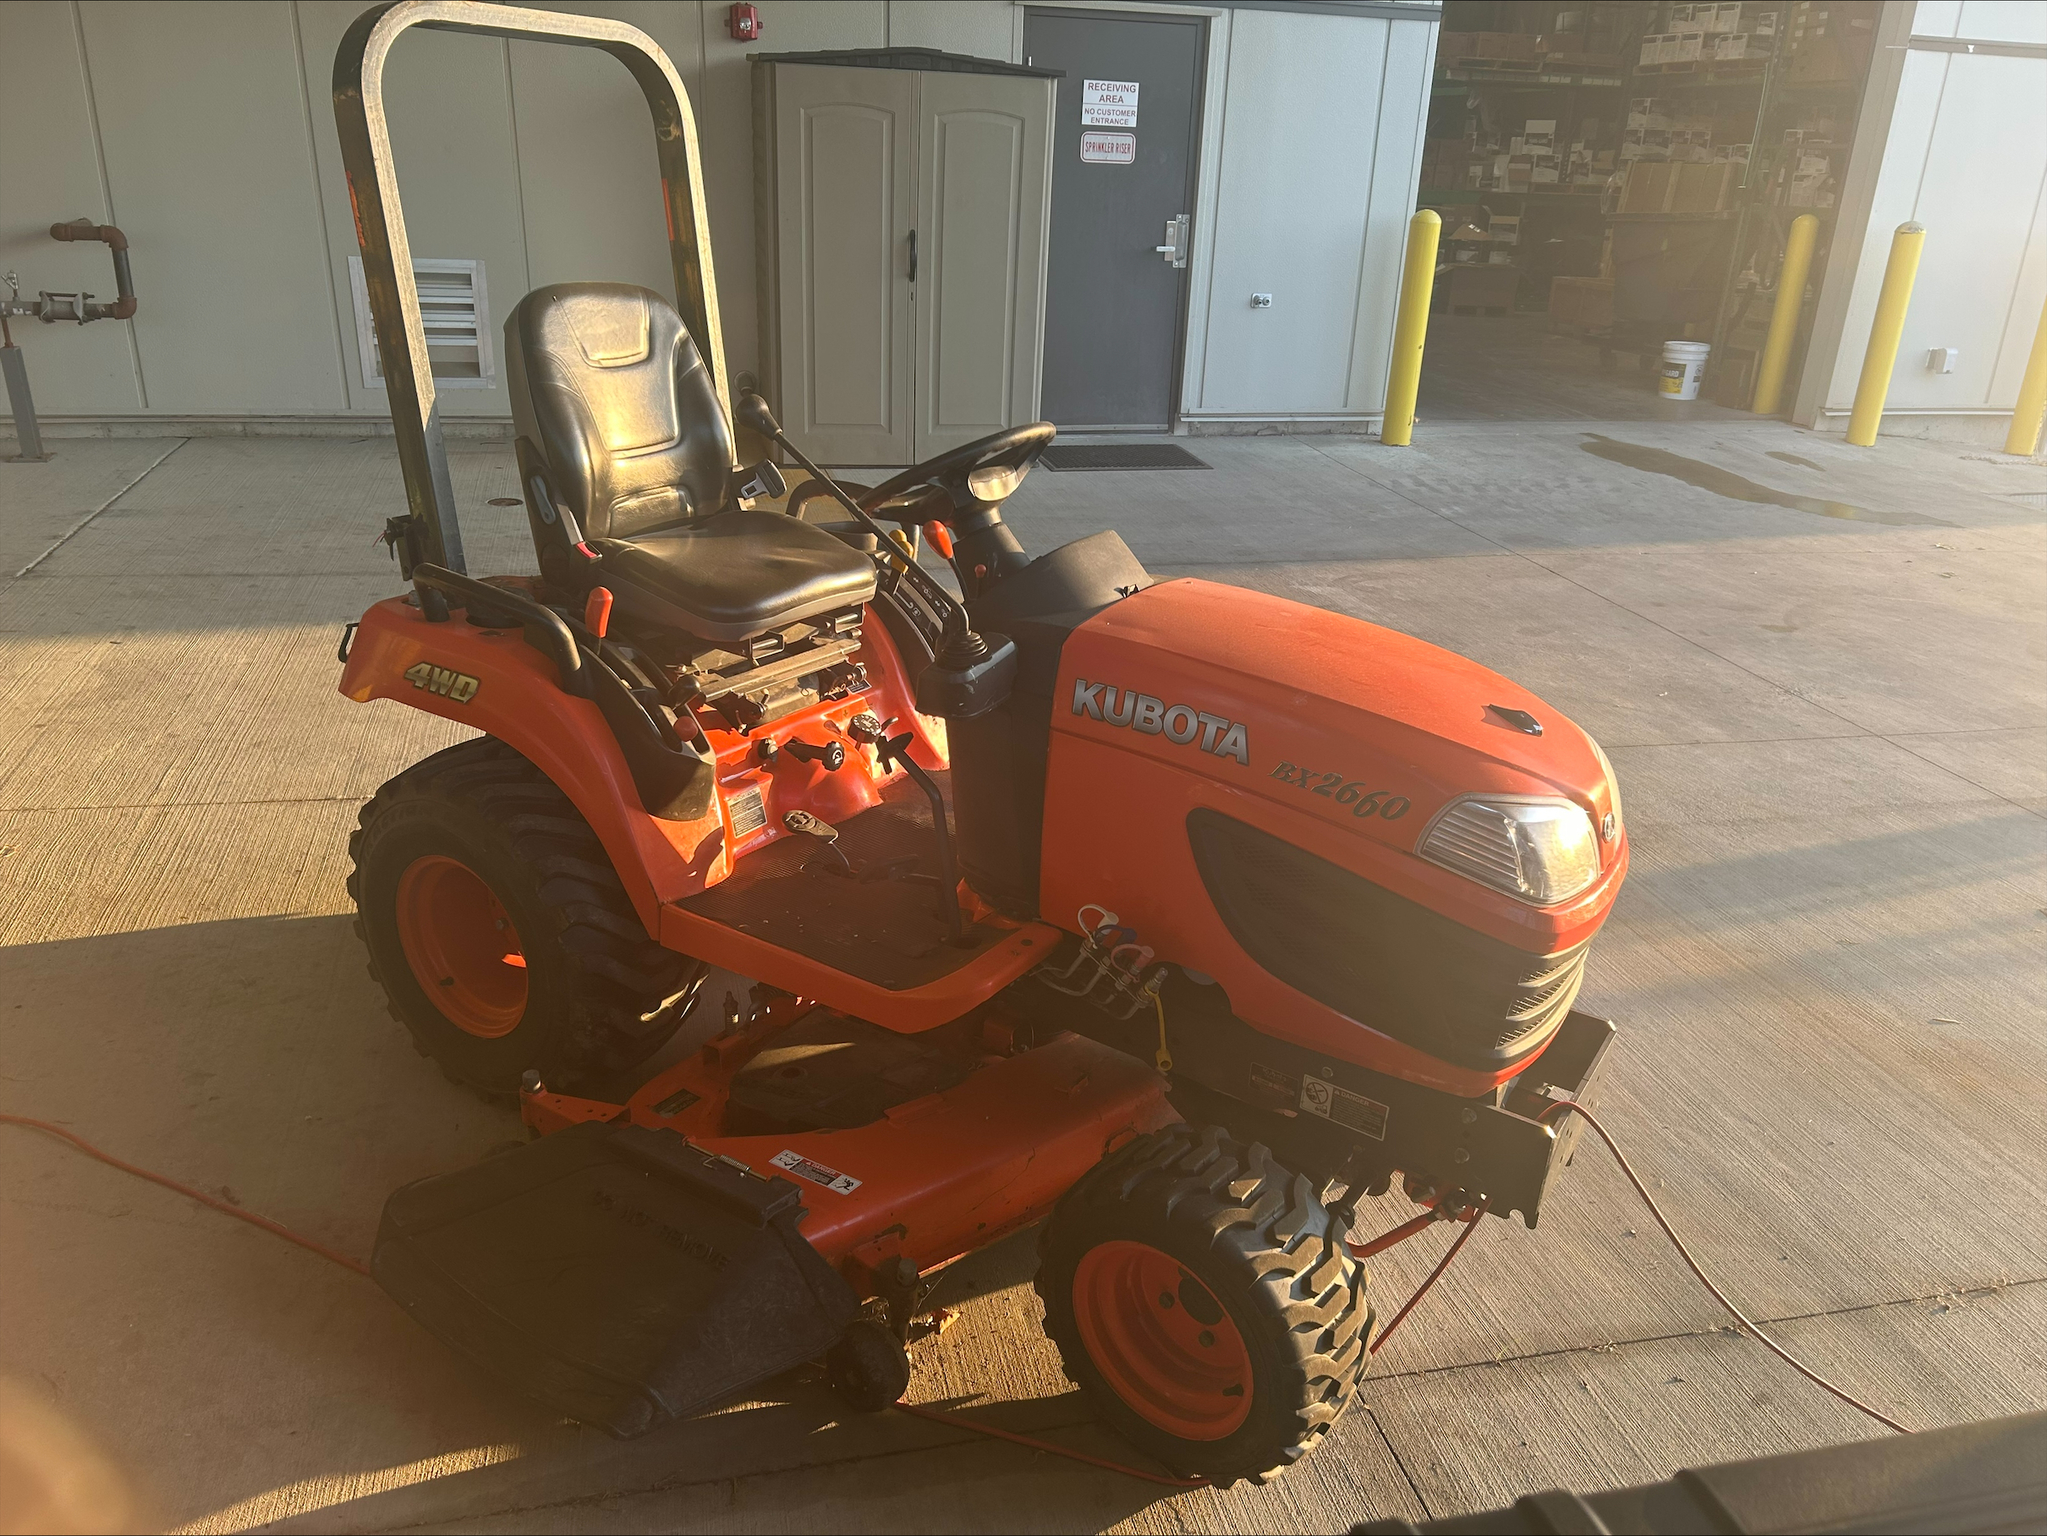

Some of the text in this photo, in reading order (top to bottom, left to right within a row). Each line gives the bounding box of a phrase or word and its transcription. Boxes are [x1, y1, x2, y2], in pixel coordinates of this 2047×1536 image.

[1087, 82, 1137, 93] RECEIVING
[1098, 94, 1124, 104] AREA
[1084, 107, 1136, 117] NO CUSTOMER
[1090, 116, 1129, 126] ENTRANCE
[1085, 141, 1131, 155] SPRINKLER RISER
[403, 661, 480, 704] 4WD
[1071, 677, 1250, 766] KUBOTA
[1267, 760, 1412, 821] BX2660
[1340, 1090, 1371, 1107] DANGER
